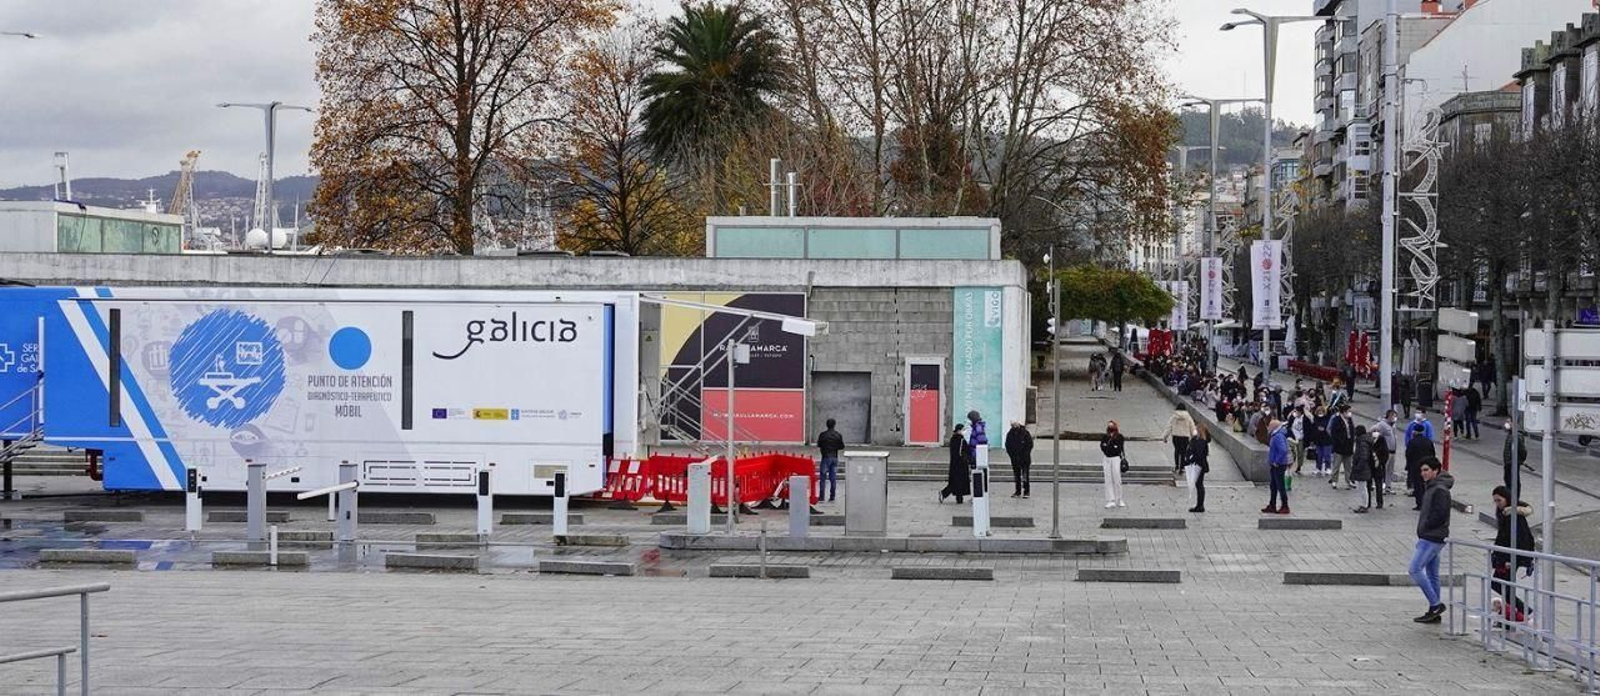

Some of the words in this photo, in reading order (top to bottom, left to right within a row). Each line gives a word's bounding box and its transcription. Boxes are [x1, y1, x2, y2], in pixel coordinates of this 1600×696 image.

[990, 291, 1000, 316] VIGO
[433, 311, 578, 360] galicia
[16, 364, 28, 373] de
[307, 375, 336, 387] PUNTO
[338, 375, 349, 387] DE
[351, 373, 392, 387] ATENCIÓN
[335, 402, 362, 418] MÓBIL
